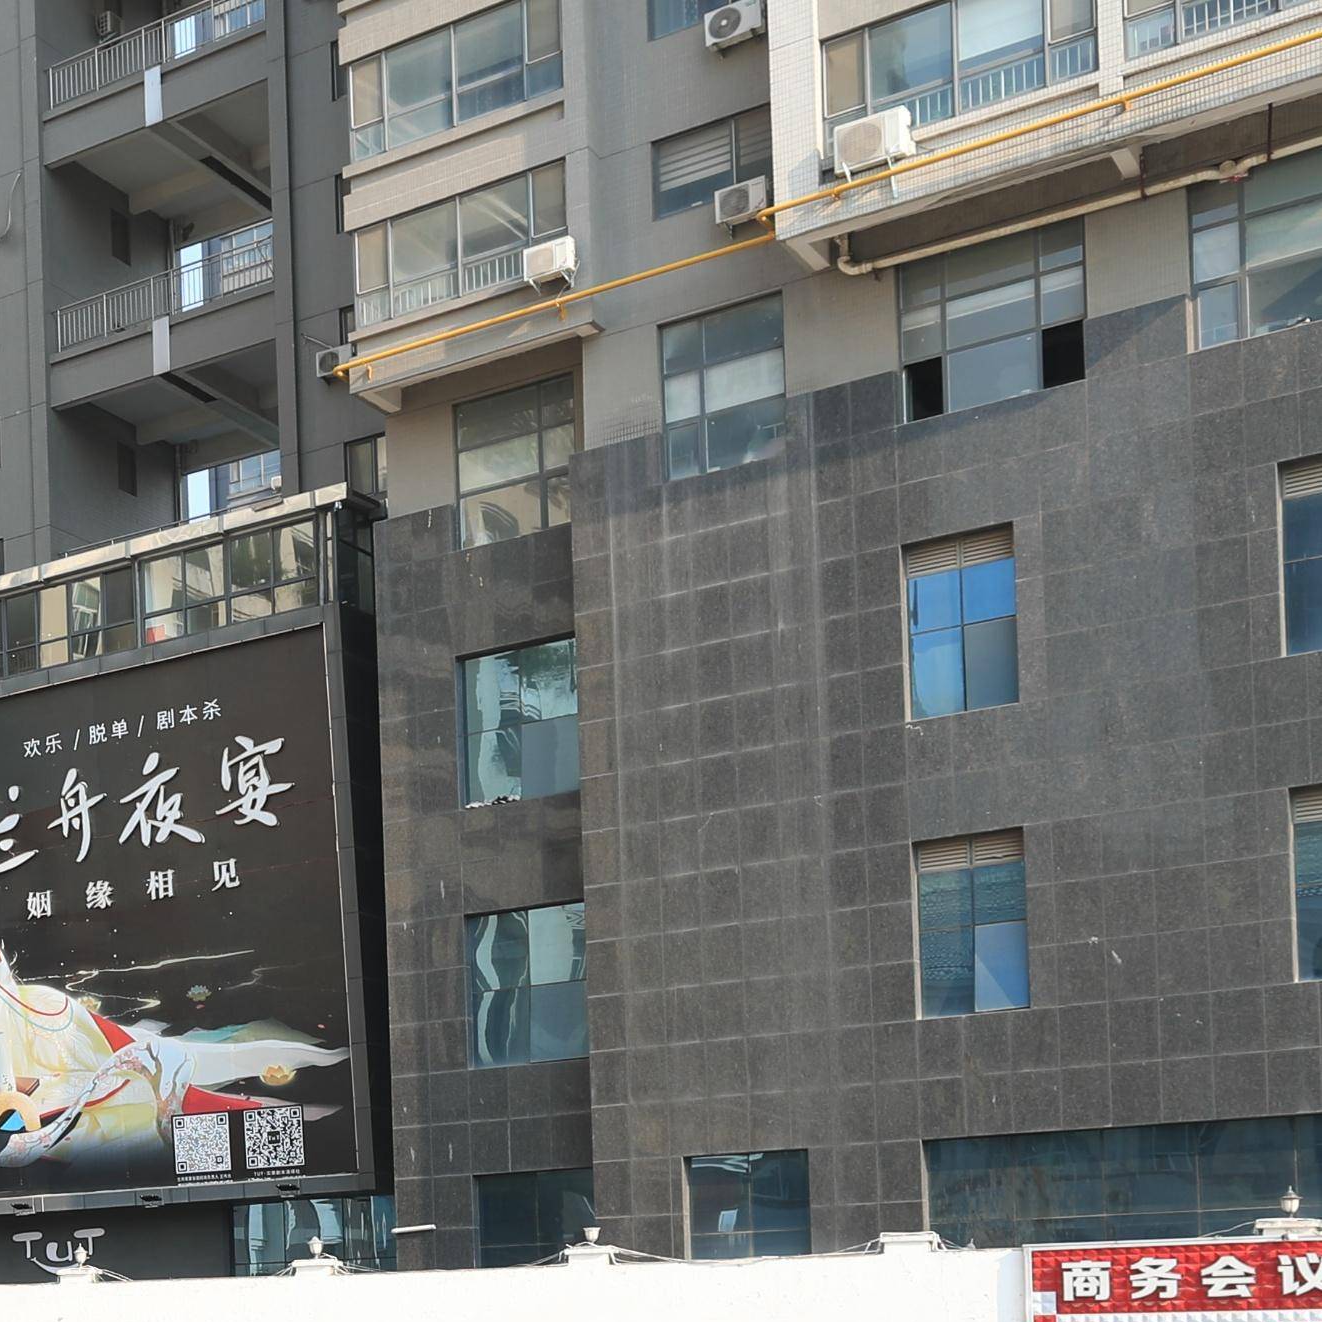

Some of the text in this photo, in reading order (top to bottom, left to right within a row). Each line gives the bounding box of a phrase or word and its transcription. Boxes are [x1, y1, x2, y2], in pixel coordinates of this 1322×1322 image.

[23, 732, 63, 758] 欢乐
[88, 718, 129, 745] 脱单
[156, 698, 222, 731] 剧本杀
[26, 858, 241, 920] 姻缘相见
